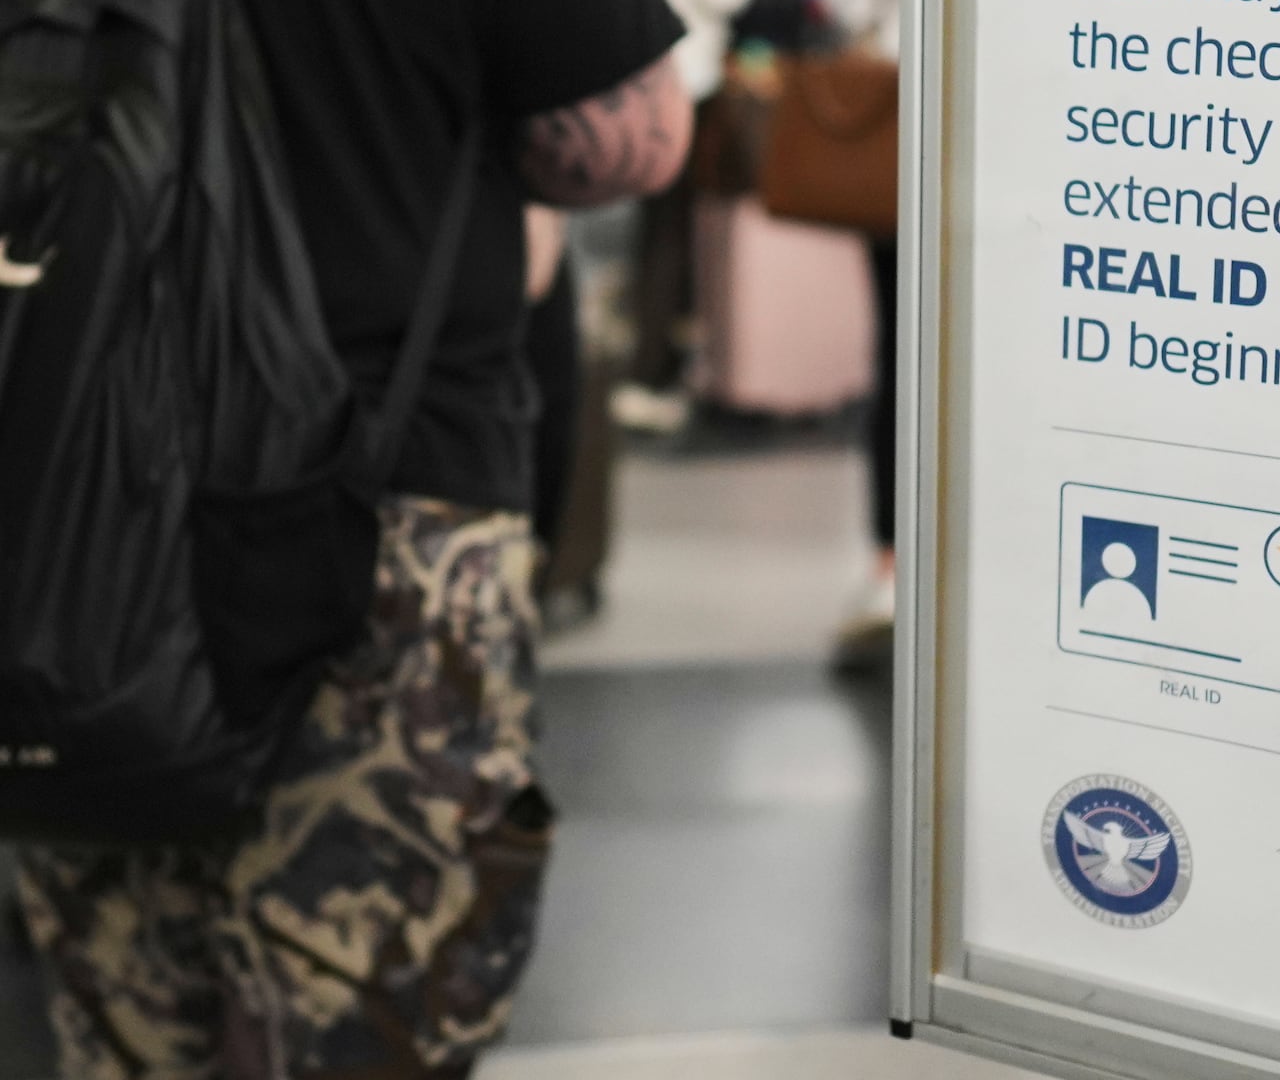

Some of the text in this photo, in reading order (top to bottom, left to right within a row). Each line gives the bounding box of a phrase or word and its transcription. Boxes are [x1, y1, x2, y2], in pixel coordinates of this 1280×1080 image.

[1069, 21, 1149, 72] the
[1066, 103, 1273, 165] security
[1063, 243, 1197, 301] REAL
[1213, 258, 1267, 307] ID
[1062, 316, 1110, 362] ID
[1159, 680, 1221, 704] REAL ID
